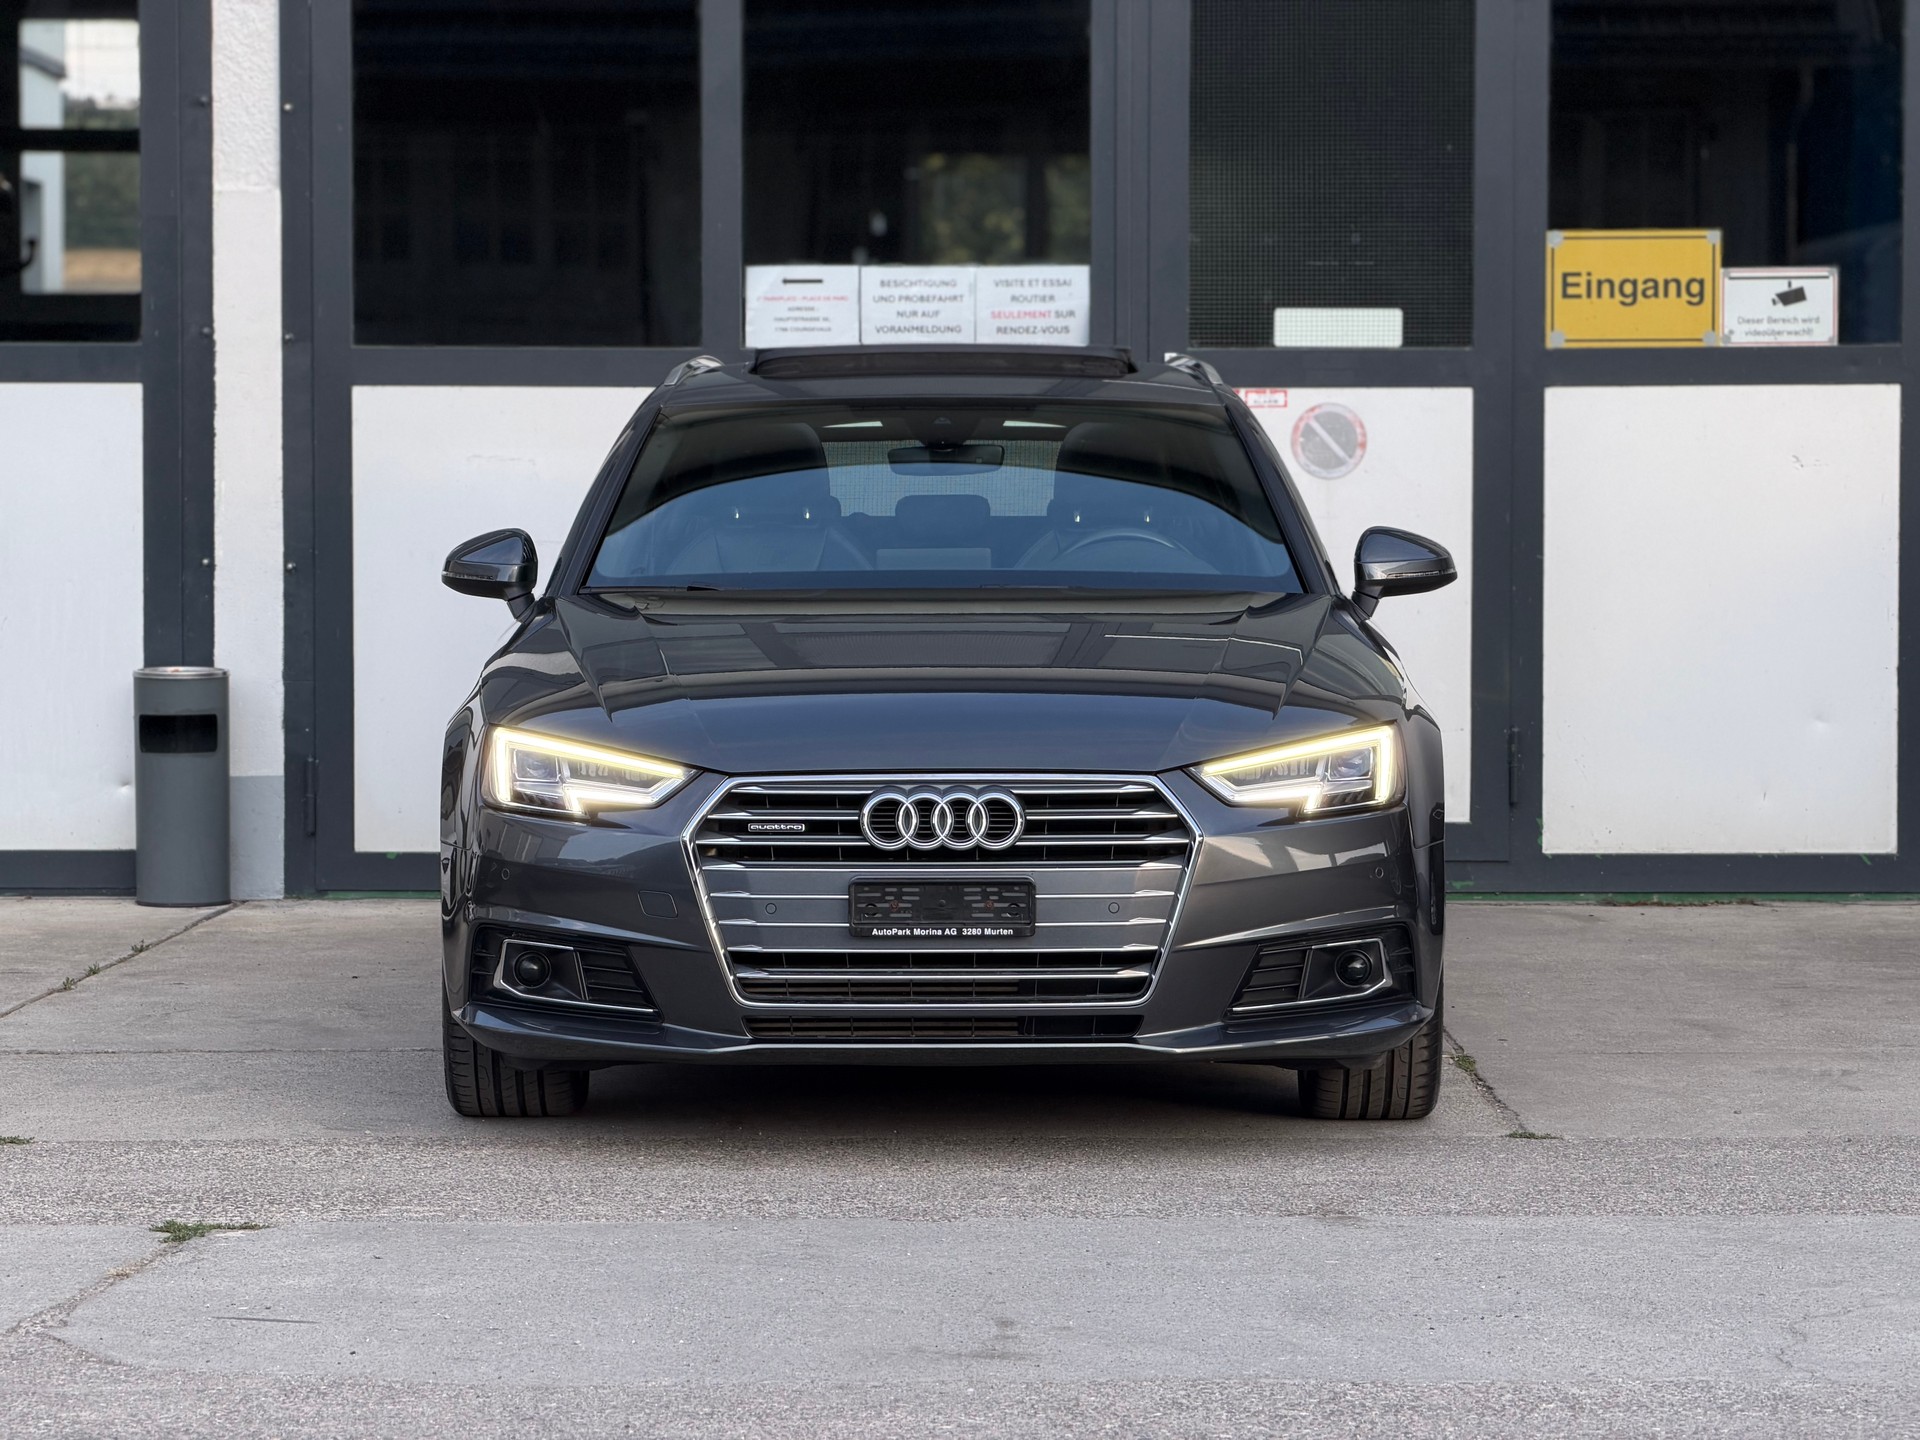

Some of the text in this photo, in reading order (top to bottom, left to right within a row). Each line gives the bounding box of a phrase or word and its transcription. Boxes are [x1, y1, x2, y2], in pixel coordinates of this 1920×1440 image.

[879, 279, 957, 288] BESICHTIGUNG
[993, 278, 1072, 287] VISITE ET ESSAI
[1560, 272, 1706, 307] Eingang
[872, 294, 964, 303] UND PROBEFAHRT
[1010, 294, 1055, 303] ROUTIER
[896, 310, 941, 319] NUR AUF
[990, 310, 1076, 319] SEULEMENT SUR
[1737, 315, 1820, 325] Dieser Bereich wird
[875, 325, 962, 334] VORANMELDUNG
[996, 325, 1070, 335] RENDEZ-VOUS
[871, 928, 1014, 936] AutoPark Morina AG 3280 Murten
